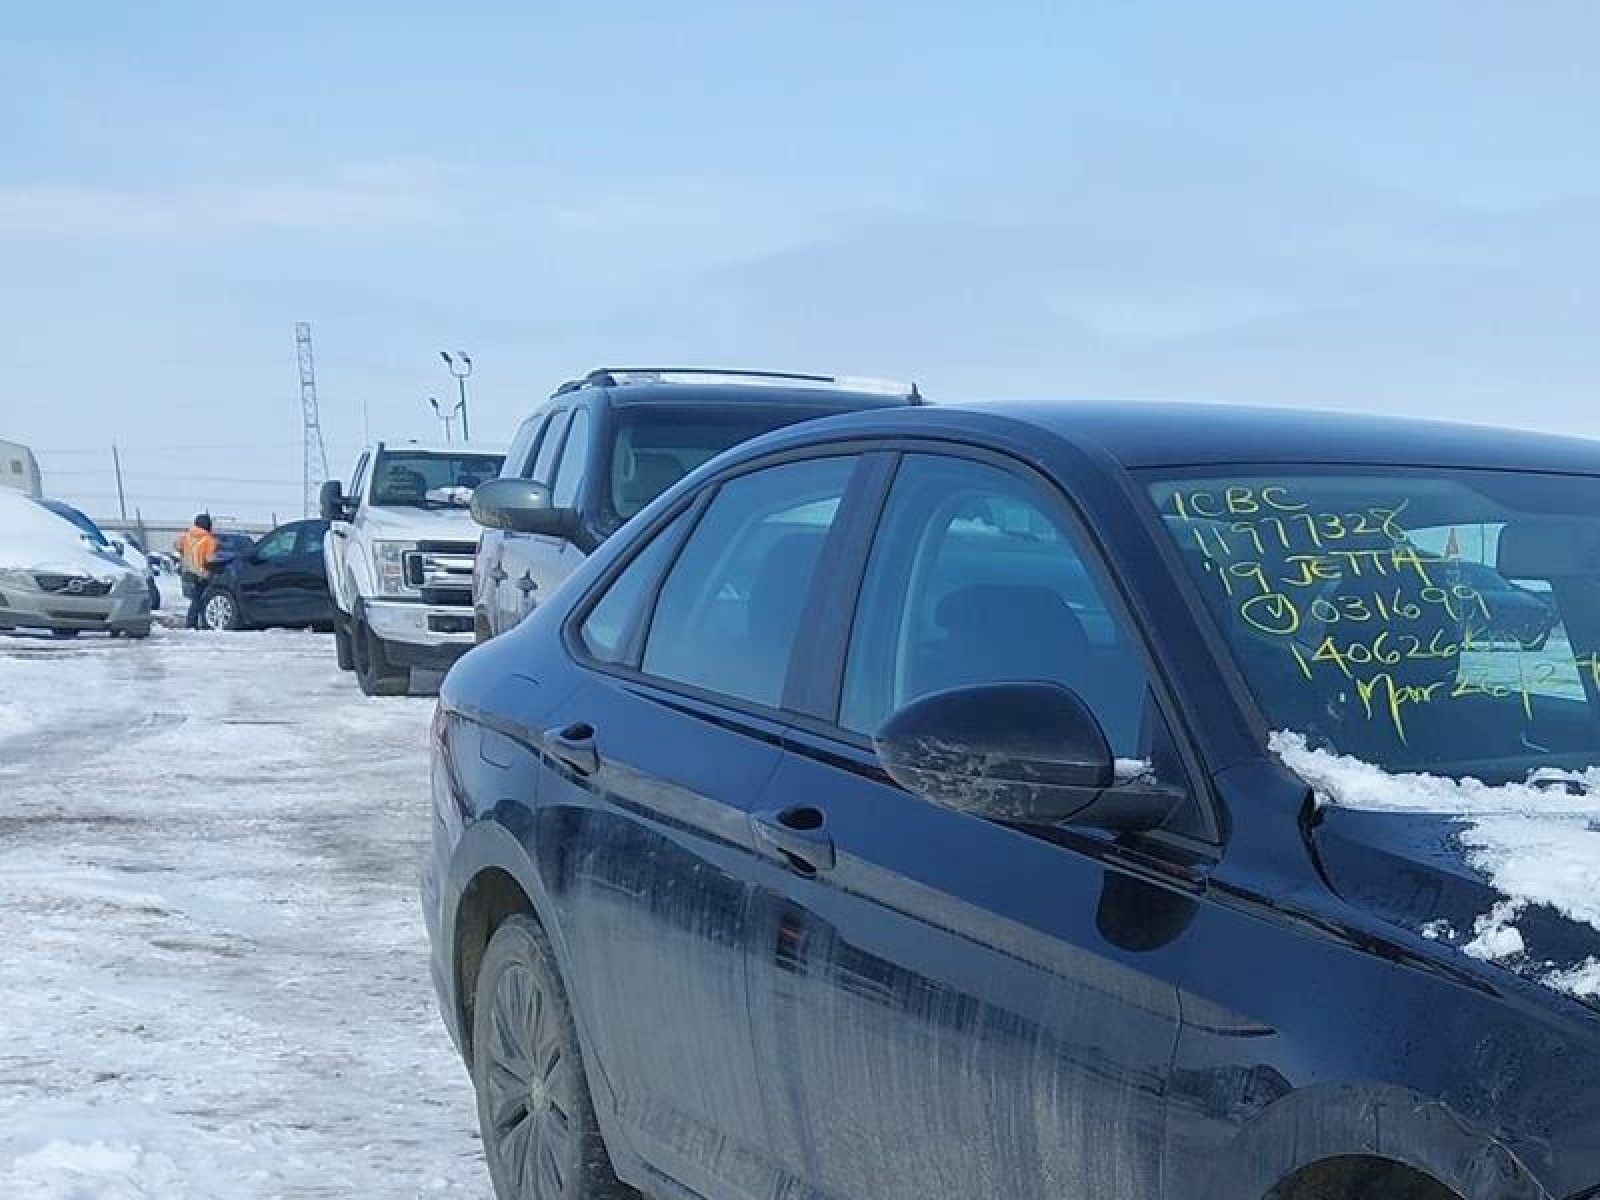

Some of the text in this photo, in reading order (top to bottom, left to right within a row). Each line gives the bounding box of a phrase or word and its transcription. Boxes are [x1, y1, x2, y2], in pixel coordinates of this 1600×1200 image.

[1192, 498, 1409, 559] 11977328
[1279, 546, 1459, 588] JETTA
[1312, 585, 1491, 622] 031699
